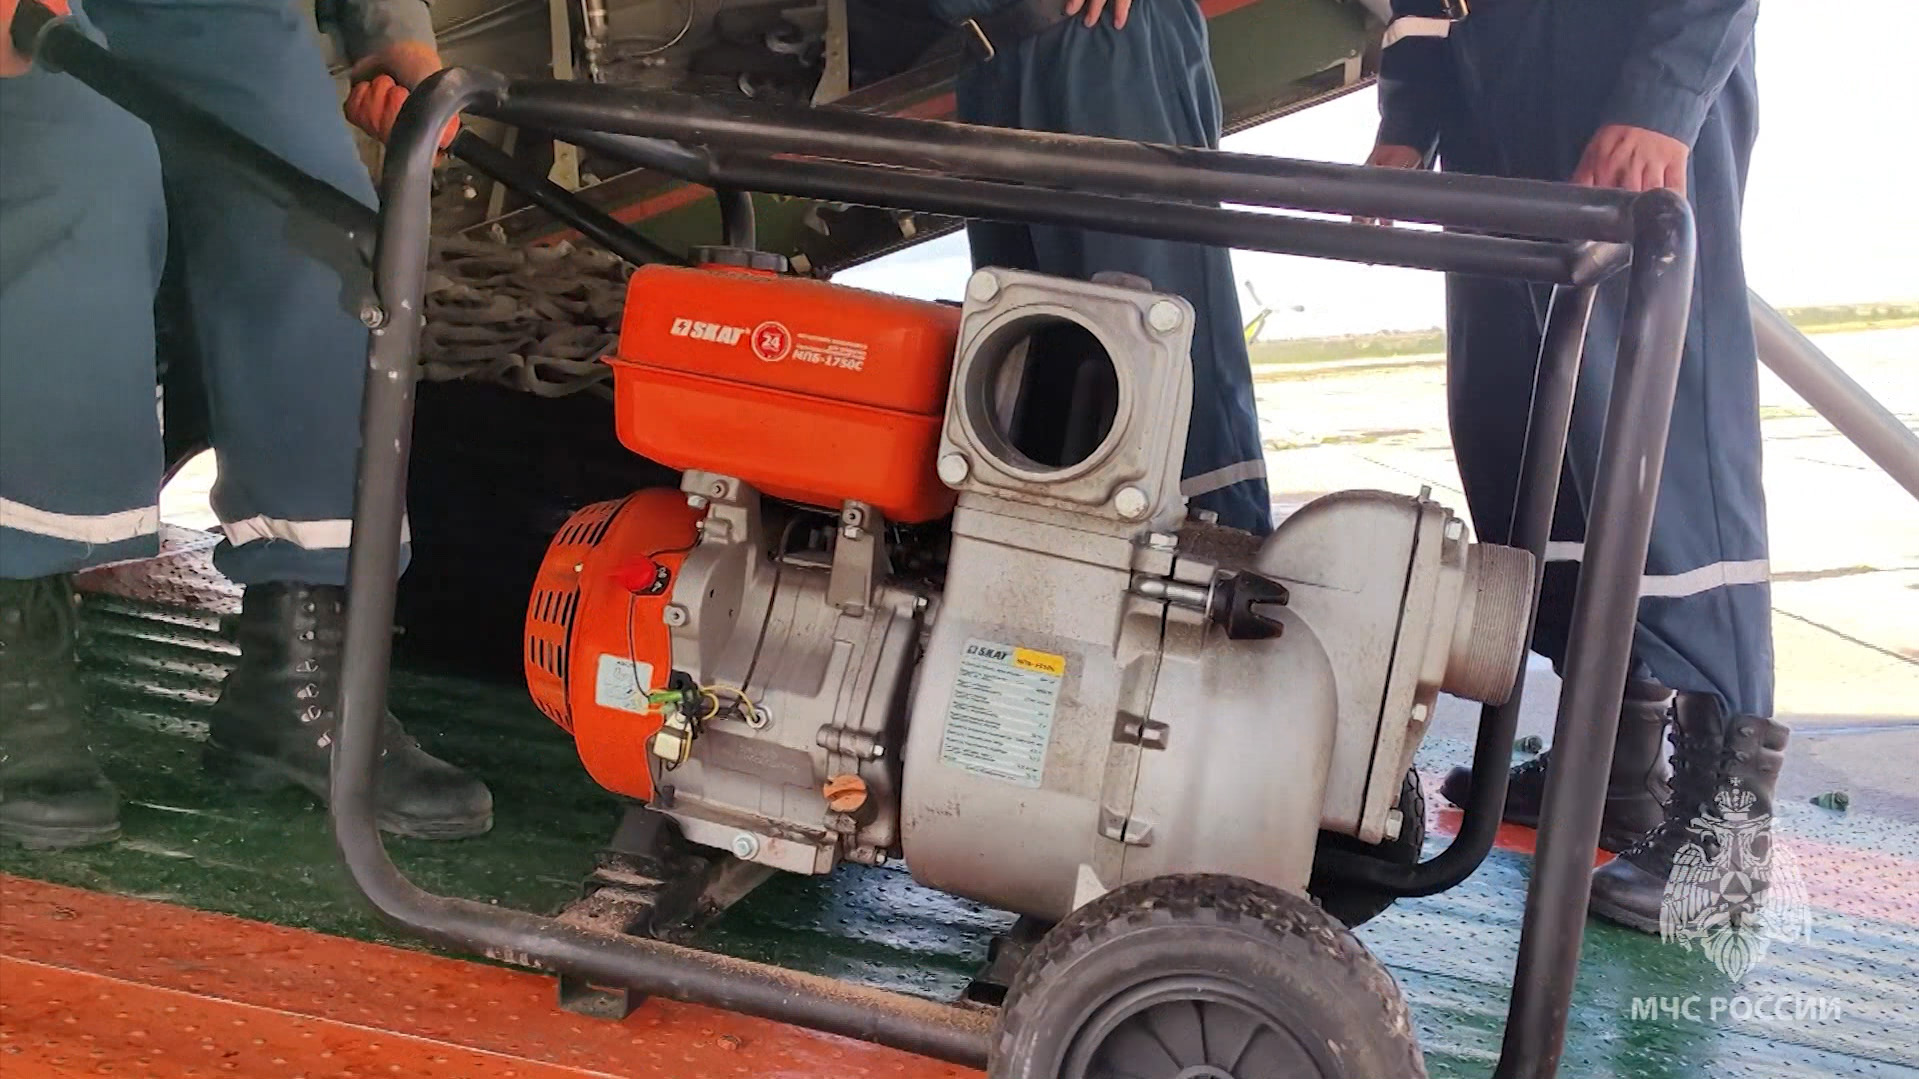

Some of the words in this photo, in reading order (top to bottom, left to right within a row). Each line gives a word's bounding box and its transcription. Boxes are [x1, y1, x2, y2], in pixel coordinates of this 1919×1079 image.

[690, 320, 744, 346] SKAT
[761, 333, 781, 350] 24
[978, 647, 1008, 661] SKAT
